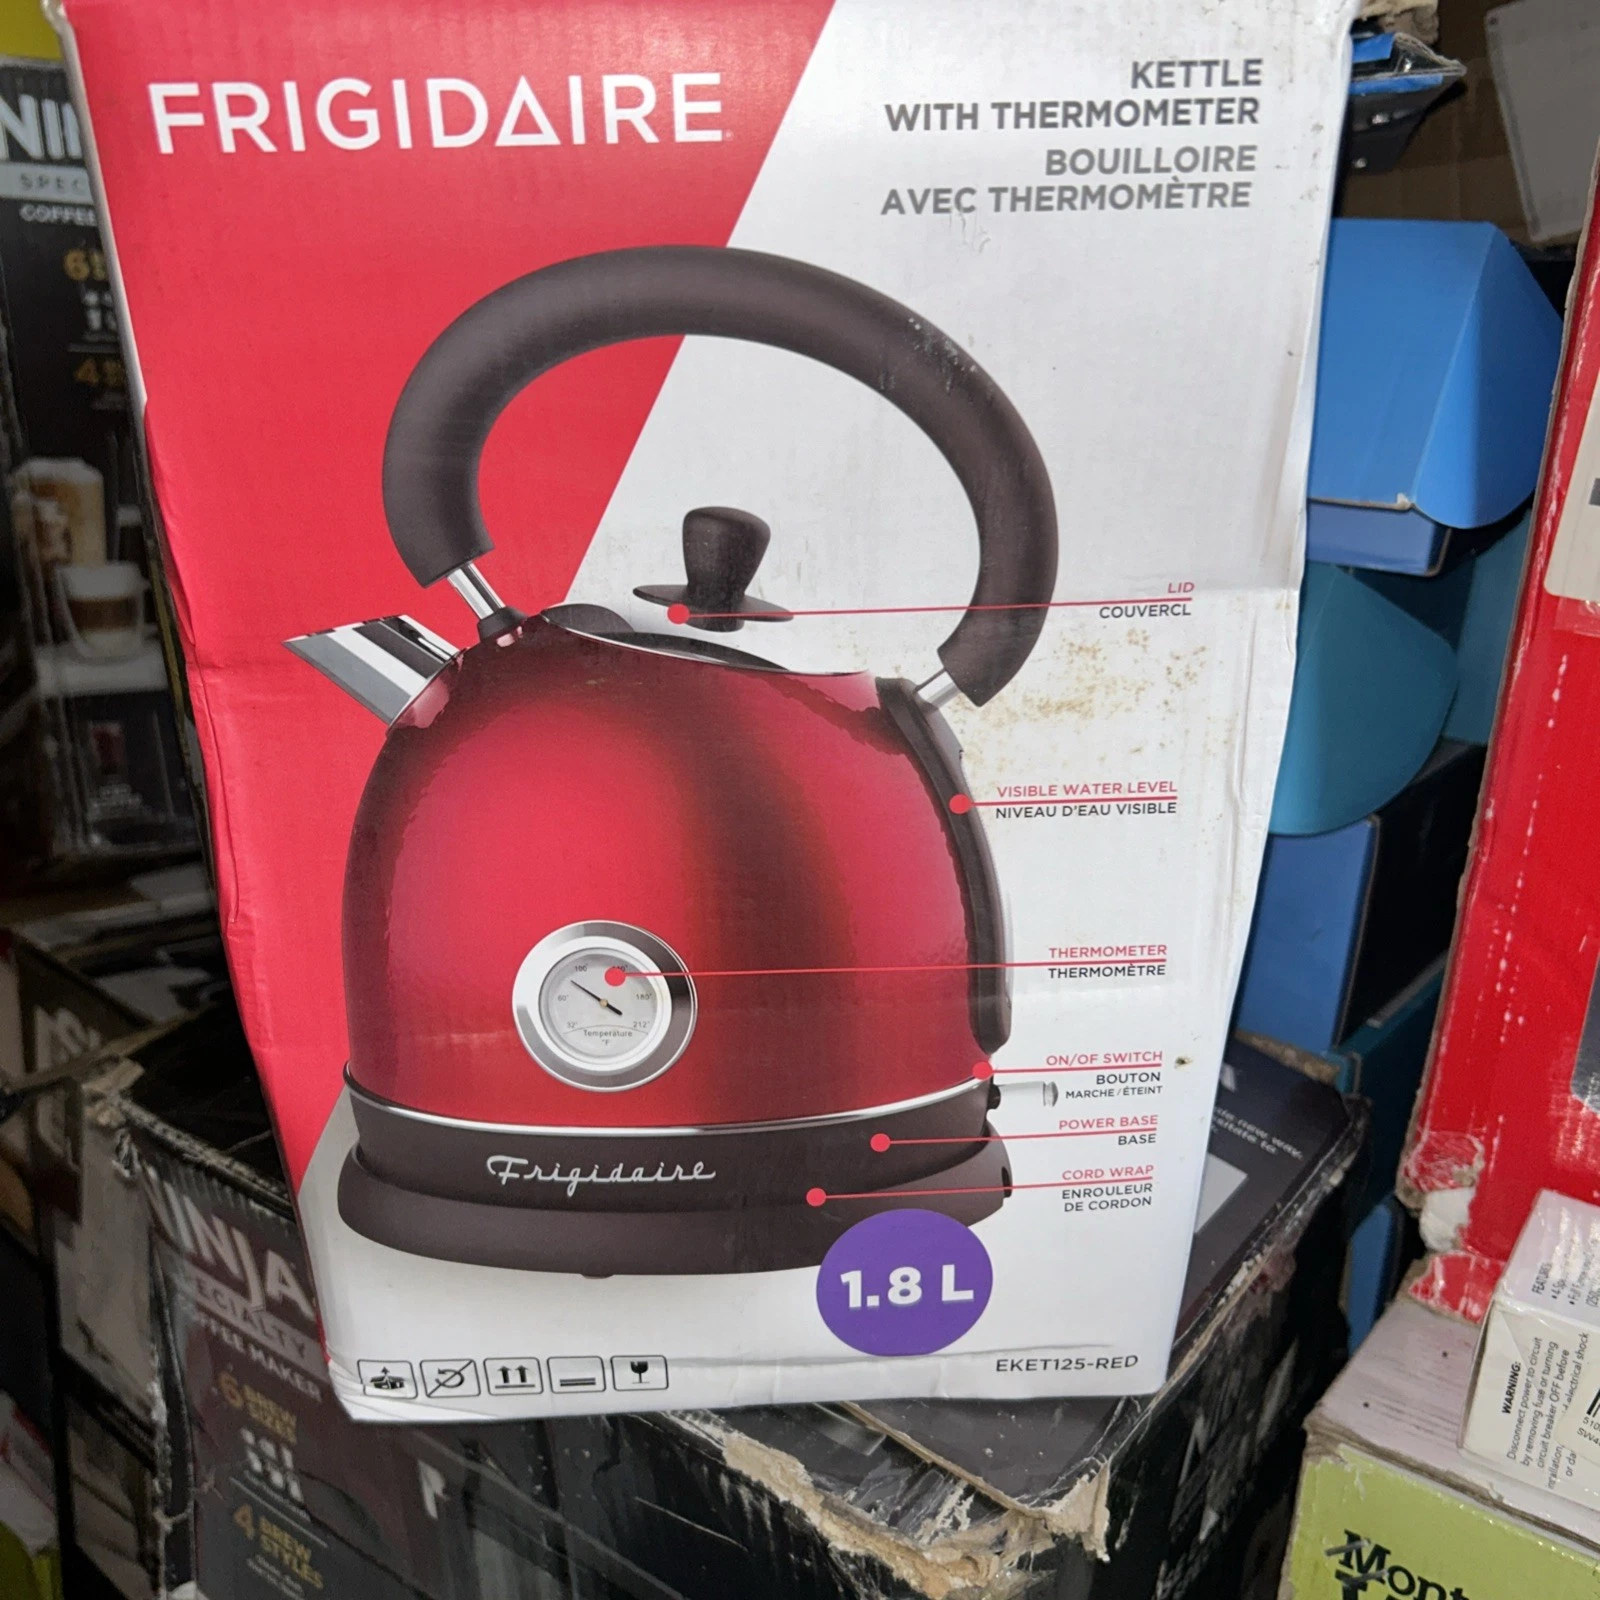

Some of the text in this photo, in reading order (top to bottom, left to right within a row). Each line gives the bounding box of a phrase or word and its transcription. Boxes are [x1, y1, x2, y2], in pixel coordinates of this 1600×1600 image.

[1131, 59, 1262, 89] KETTLE
[148, 72, 723, 154] FRIGIDAIRE
[885, 97, 1260, 131] WITH THERMOMETER
[1046, 145, 1257, 176] BOUILLOIRE
[881, 176, 1252, 215] AVEC THERMOMÈTRE
[1167, 582, 1195, 594] LID
[1100, 604, 1191, 618] COUVERCL
[997, 781, 1177, 797] VISIBLE WATER LEVEL
[996, 802, 1177, 819] NIVEAU D'EAU VISIBLE
[1048, 944, 1167, 959] THERMOMETER
[1048, 963, 1166, 979] THERMOMÈTRE
[584, 1029, 633, 1038] Temperature
[1046, 1051, 1163, 1066] ON/OF SWITCH
[1096, 1071, 1161, 1085] BOUTON
[1059, 1115, 1158, 1130] POWER BASE
[1118, 1133, 1156, 1146] BASE
[486, 1155, 716, 1197] Frigidaire
[1062, 1165, 1154, 1181] CORD WRAP
[1062, 1183, 1153, 1200] ENROULEUR
[1064, 1197, 1152, 1212] DE CORDON
[840, 1264, 974, 1309] 1.8 L
[1577, 1332, 1590, 1361] shock
[996, 1355, 1139, 1373] EKET125-RED
[1502, 1361, 1521, 1415] WARNING:
[1507, 1336, 1543, 1461] Disconnect power to circuit
[1521, 1341, 1559, 1467] by removing fuse or turning
[1537, 1349, 1570, 1468] circuit breaker OFF before
[1565, 1466, 1574, 1477] or
